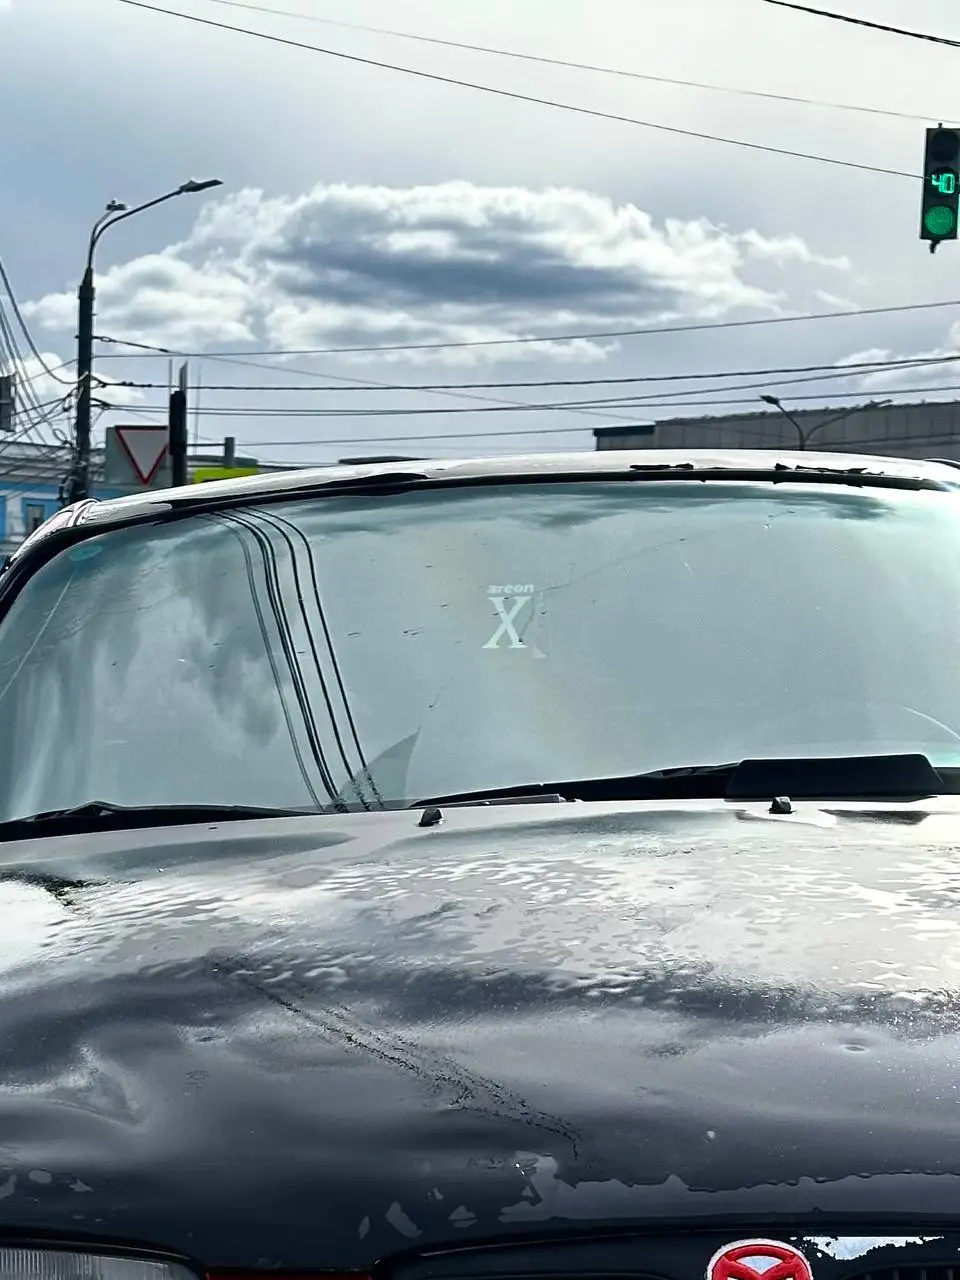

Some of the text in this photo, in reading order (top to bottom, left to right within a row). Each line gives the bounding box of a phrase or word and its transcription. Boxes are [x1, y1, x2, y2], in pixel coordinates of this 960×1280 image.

[931, 173, 955, 193] 40
[486, 583, 535, 594] areon
[481, 596, 531, 649] X
